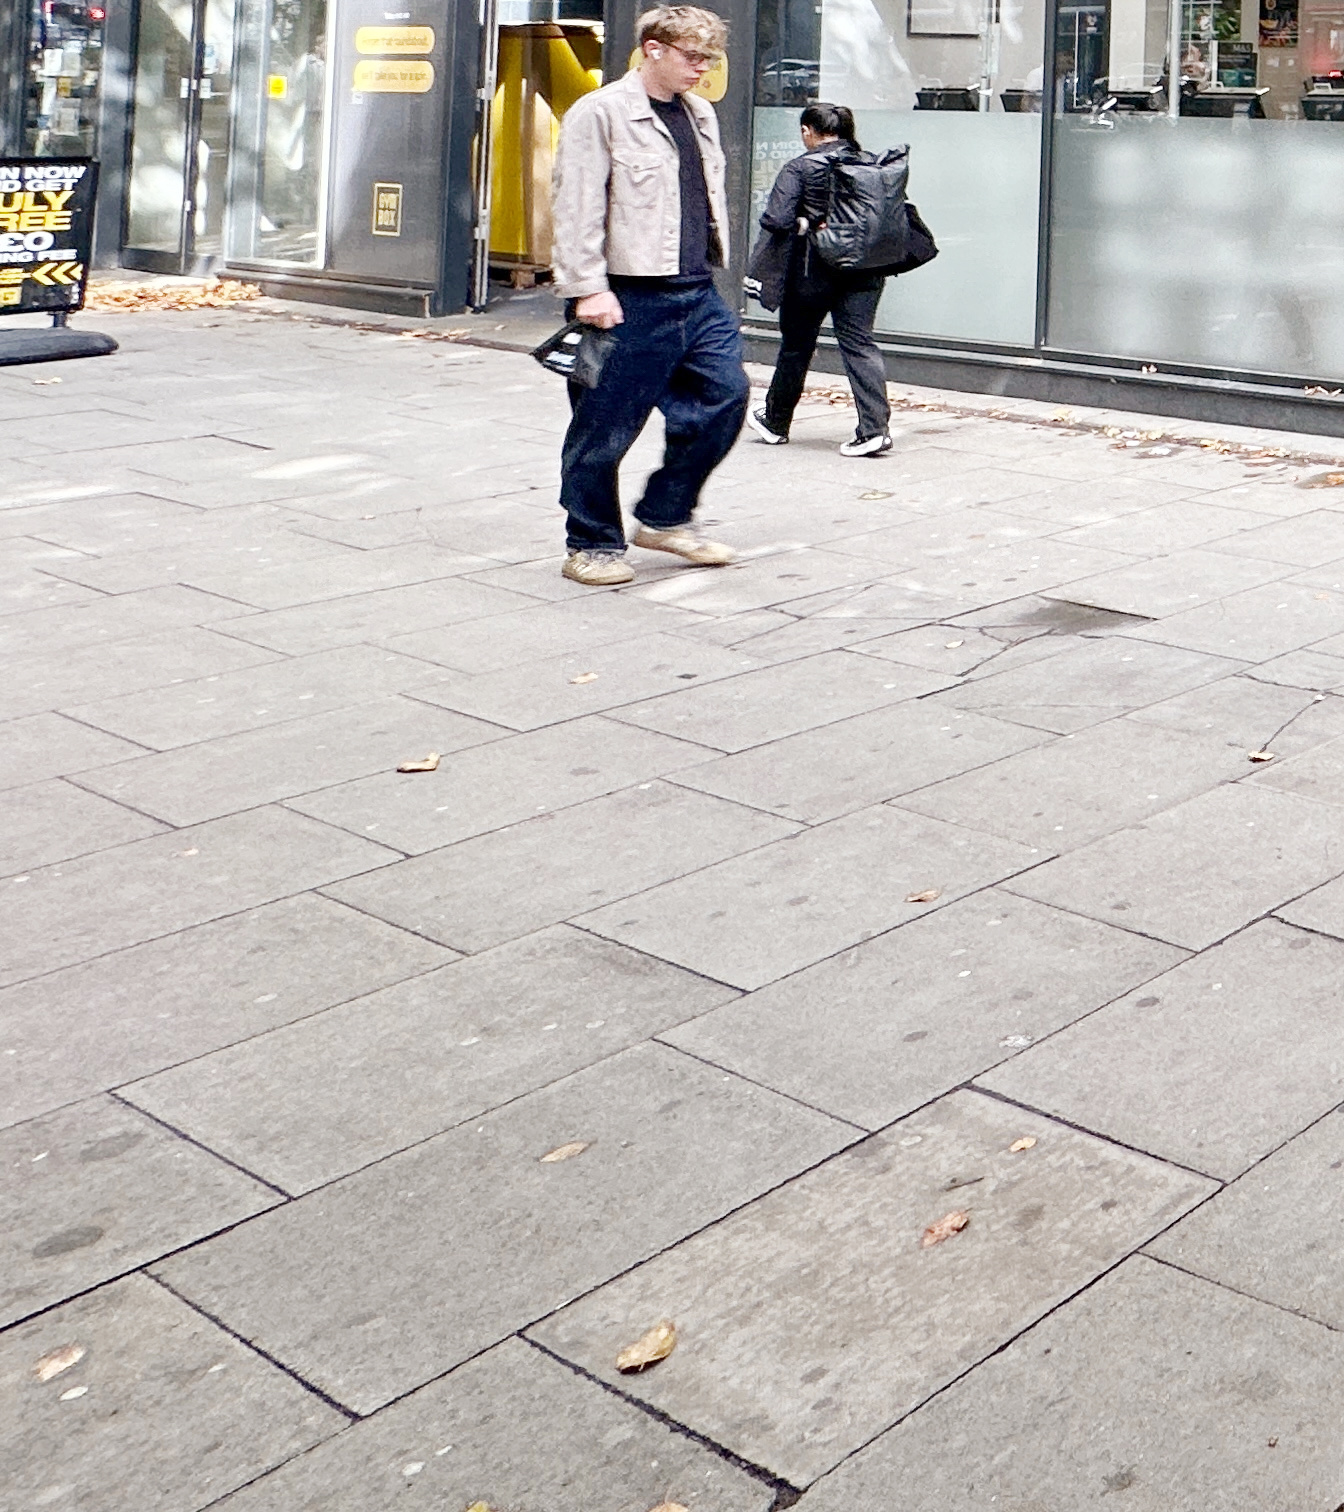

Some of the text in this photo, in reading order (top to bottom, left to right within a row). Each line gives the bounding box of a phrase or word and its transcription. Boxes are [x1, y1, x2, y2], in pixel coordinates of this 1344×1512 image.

[25, 166, 87, 180] NOW
[25, 178, 79, 193] GET
[37, 248, 78, 262] FEE
